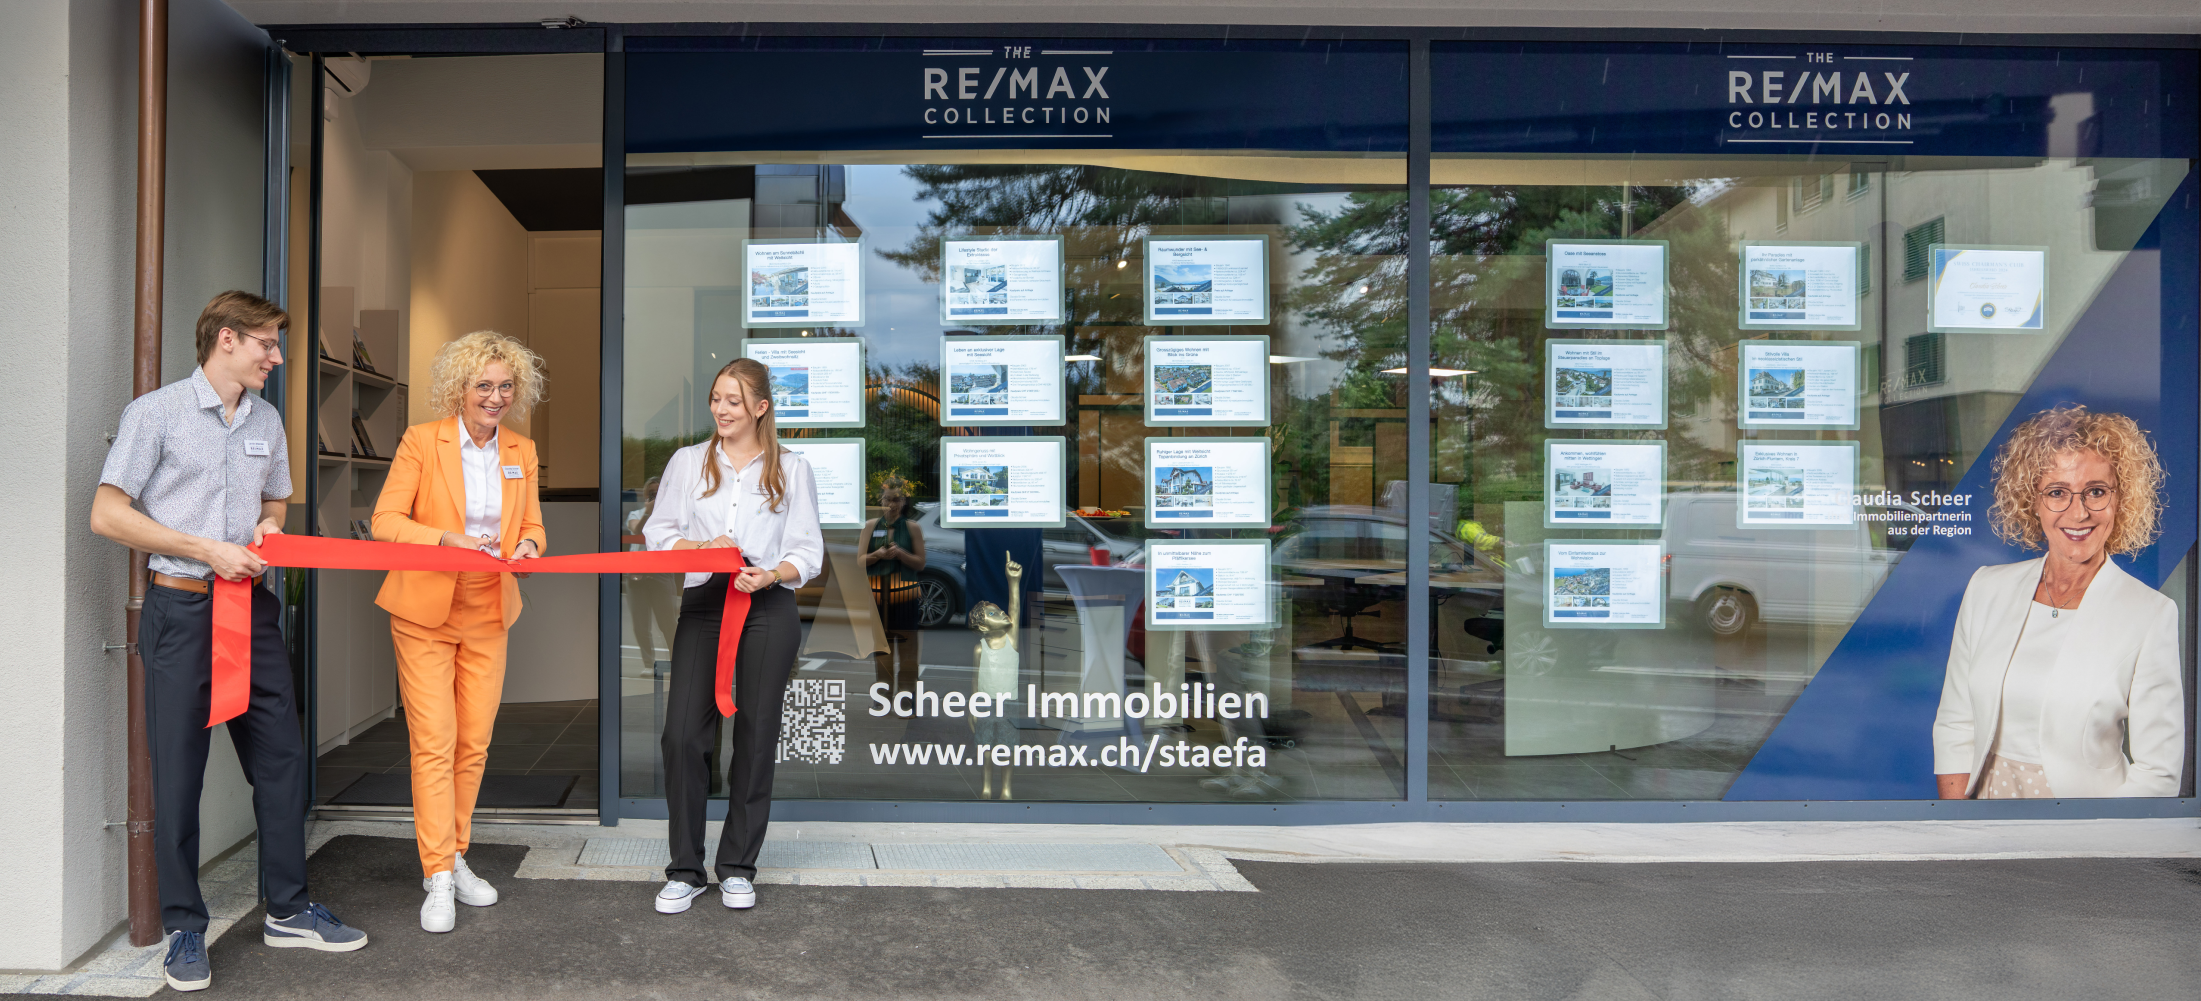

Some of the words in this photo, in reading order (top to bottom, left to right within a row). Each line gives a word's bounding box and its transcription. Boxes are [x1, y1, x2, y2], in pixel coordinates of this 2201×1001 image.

[1004, 46, 1032, 59] THE
[1807, 53, 1834, 63] THE
[924, 67, 1110, 100] RE/MAX
[1728, 70, 1911, 105] RE/MAX
[924, 107, 1110, 124] COLLECTION
[1729, 111, 1911, 130] COLLECTION
[1910, 490, 1973, 506] Scheer
[1853, 511, 1972, 523] Immobilienpartnerin
[1887, 526, 1908, 535] aus
[1910, 525, 1930, 535] der
[1933, 525, 1972, 538] Region
[868, 681, 1012, 719] Scheer
[1027, 682, 1269, 720] Immobilien
[868, 735, 1267, 773] www.remax.ch/staefa
